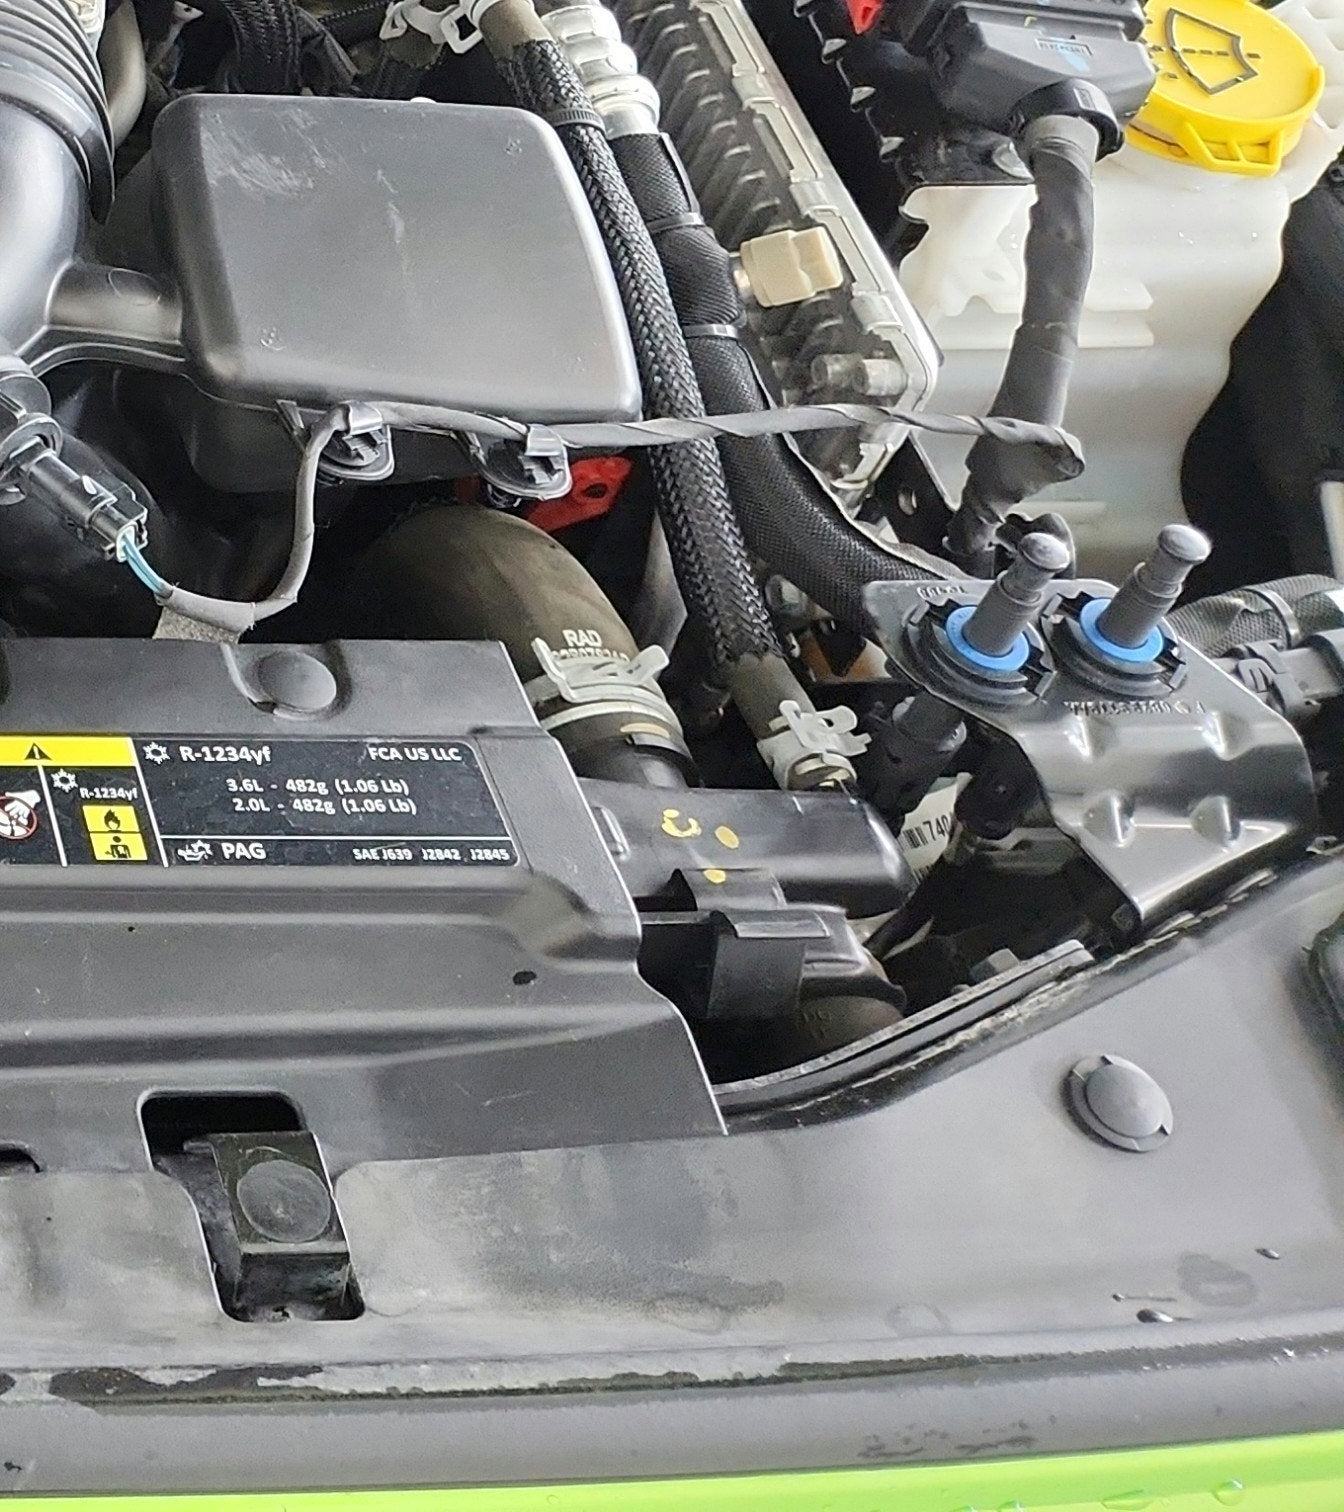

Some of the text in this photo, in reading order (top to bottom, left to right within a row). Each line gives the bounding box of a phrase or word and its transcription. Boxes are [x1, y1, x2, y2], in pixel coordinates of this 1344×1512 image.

[562, 629, 603, 647] RAD
[179, 746, 462, 766] R-1234yf FCA US LLC
[80, 787, 138, 801] R-1234yf
[226, 778, 263, 792] 3.6L
[285, 778, 329, 796] 482g
[334, 778, 379, 795] (1.06
[382, 779, 409, 796] Lb)
[232, 798, 271, 812] 2.0L
[292, 798, 336, 815] 482g
[341, 798, 386, 815] (1.06
[389, 799, 417, 816] Lb)
[221, 842, 266, 859] PAG
[352, 848, 379, 861] SAE
